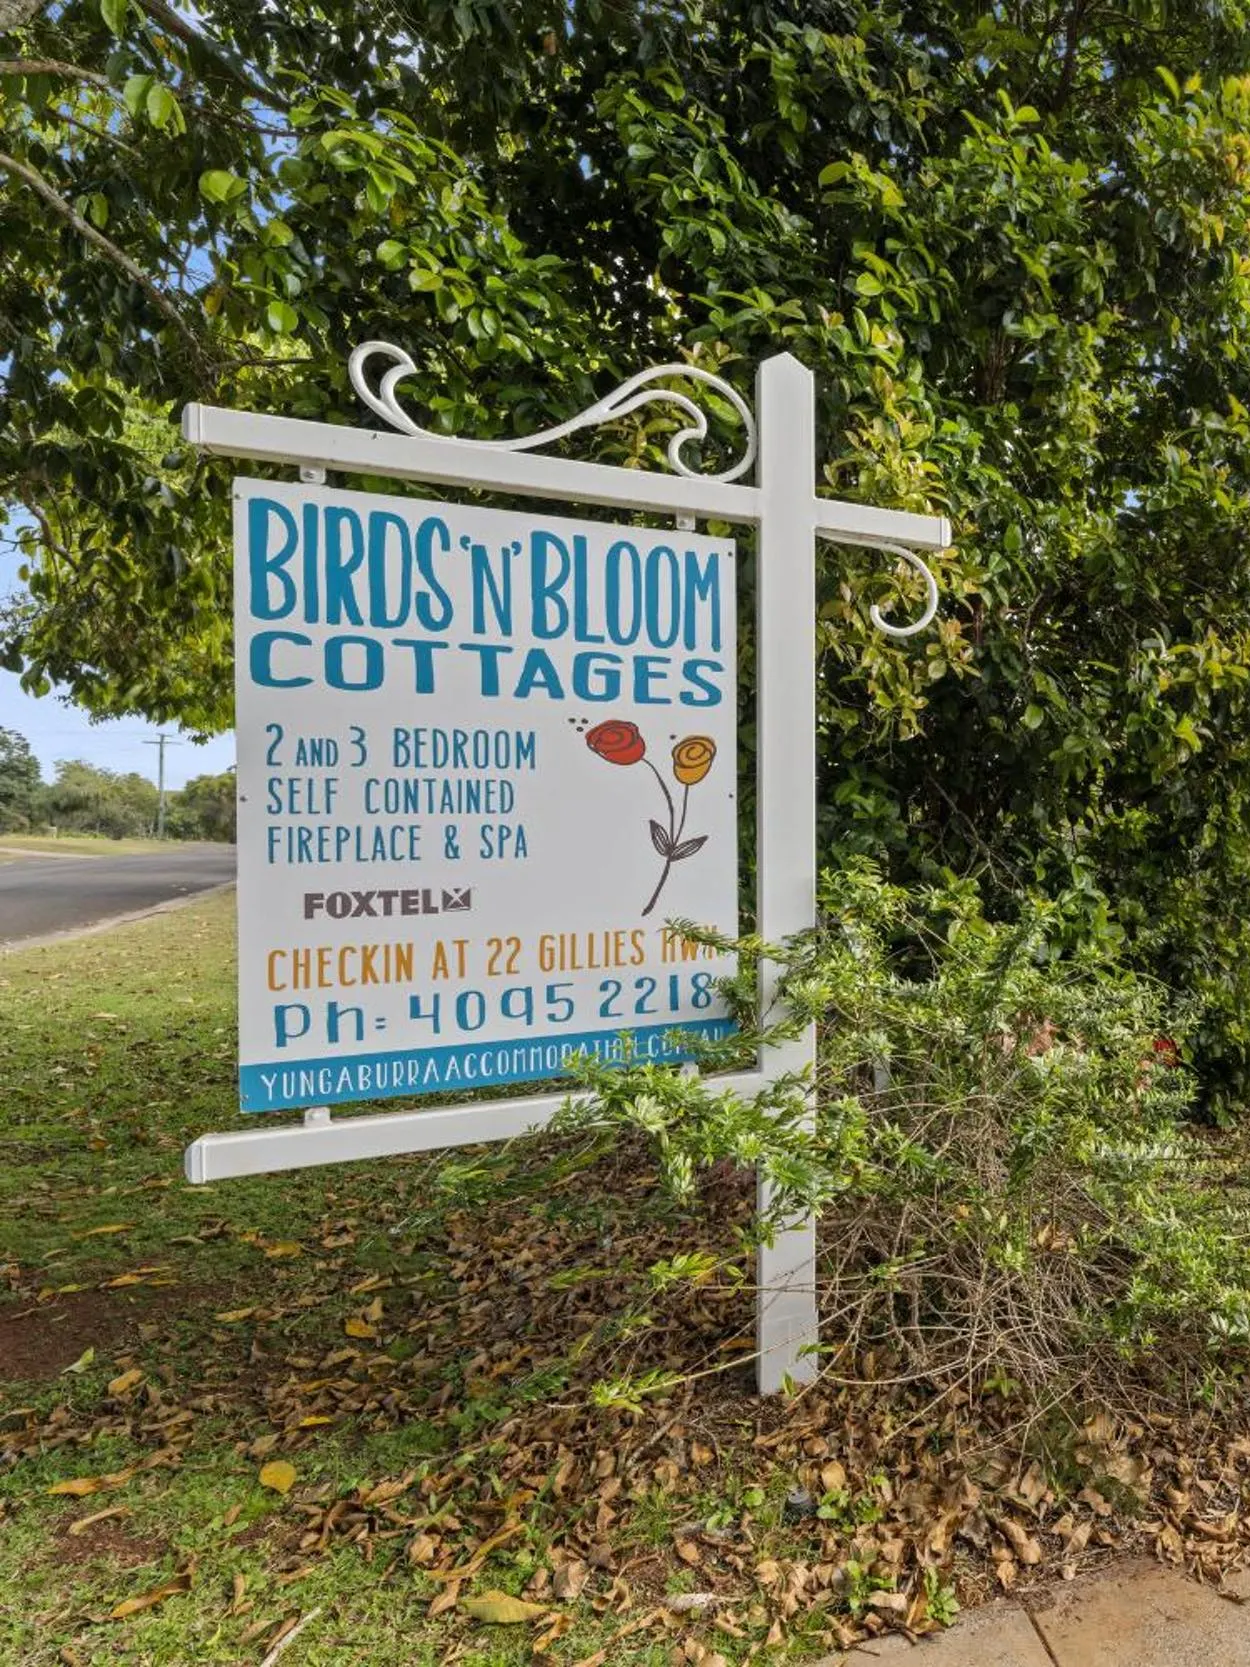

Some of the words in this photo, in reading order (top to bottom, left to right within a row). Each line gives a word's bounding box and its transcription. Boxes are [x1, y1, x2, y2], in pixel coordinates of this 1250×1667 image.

[250, 631, 725, 707] COTTAGES
[265, 724, 284, 768] 2
[295, 737, 339, 768] AND
[350, 726, 367, 768] 3
[394, 727, 536, 770] BEDROOM
[266, 778, 338, 816] SELF
[364, 778, 515, 815] CONTAINED
[266, 824, 422, 864] FIREPLACE
[444, 826, 461, 859] &
[479, 824, 528, 859] SPA
[304, 888, 439, 919] FOXTEL
[267, 941, 415, 991] CHECKIN
[431, 940, 466, 980] AT
[486, 936, 521, 977] 22
[539, 929, 644, 972] GILLIES
[408, 983, 574, 1034] 4095
[599, 973, 714, 1019] 2218
